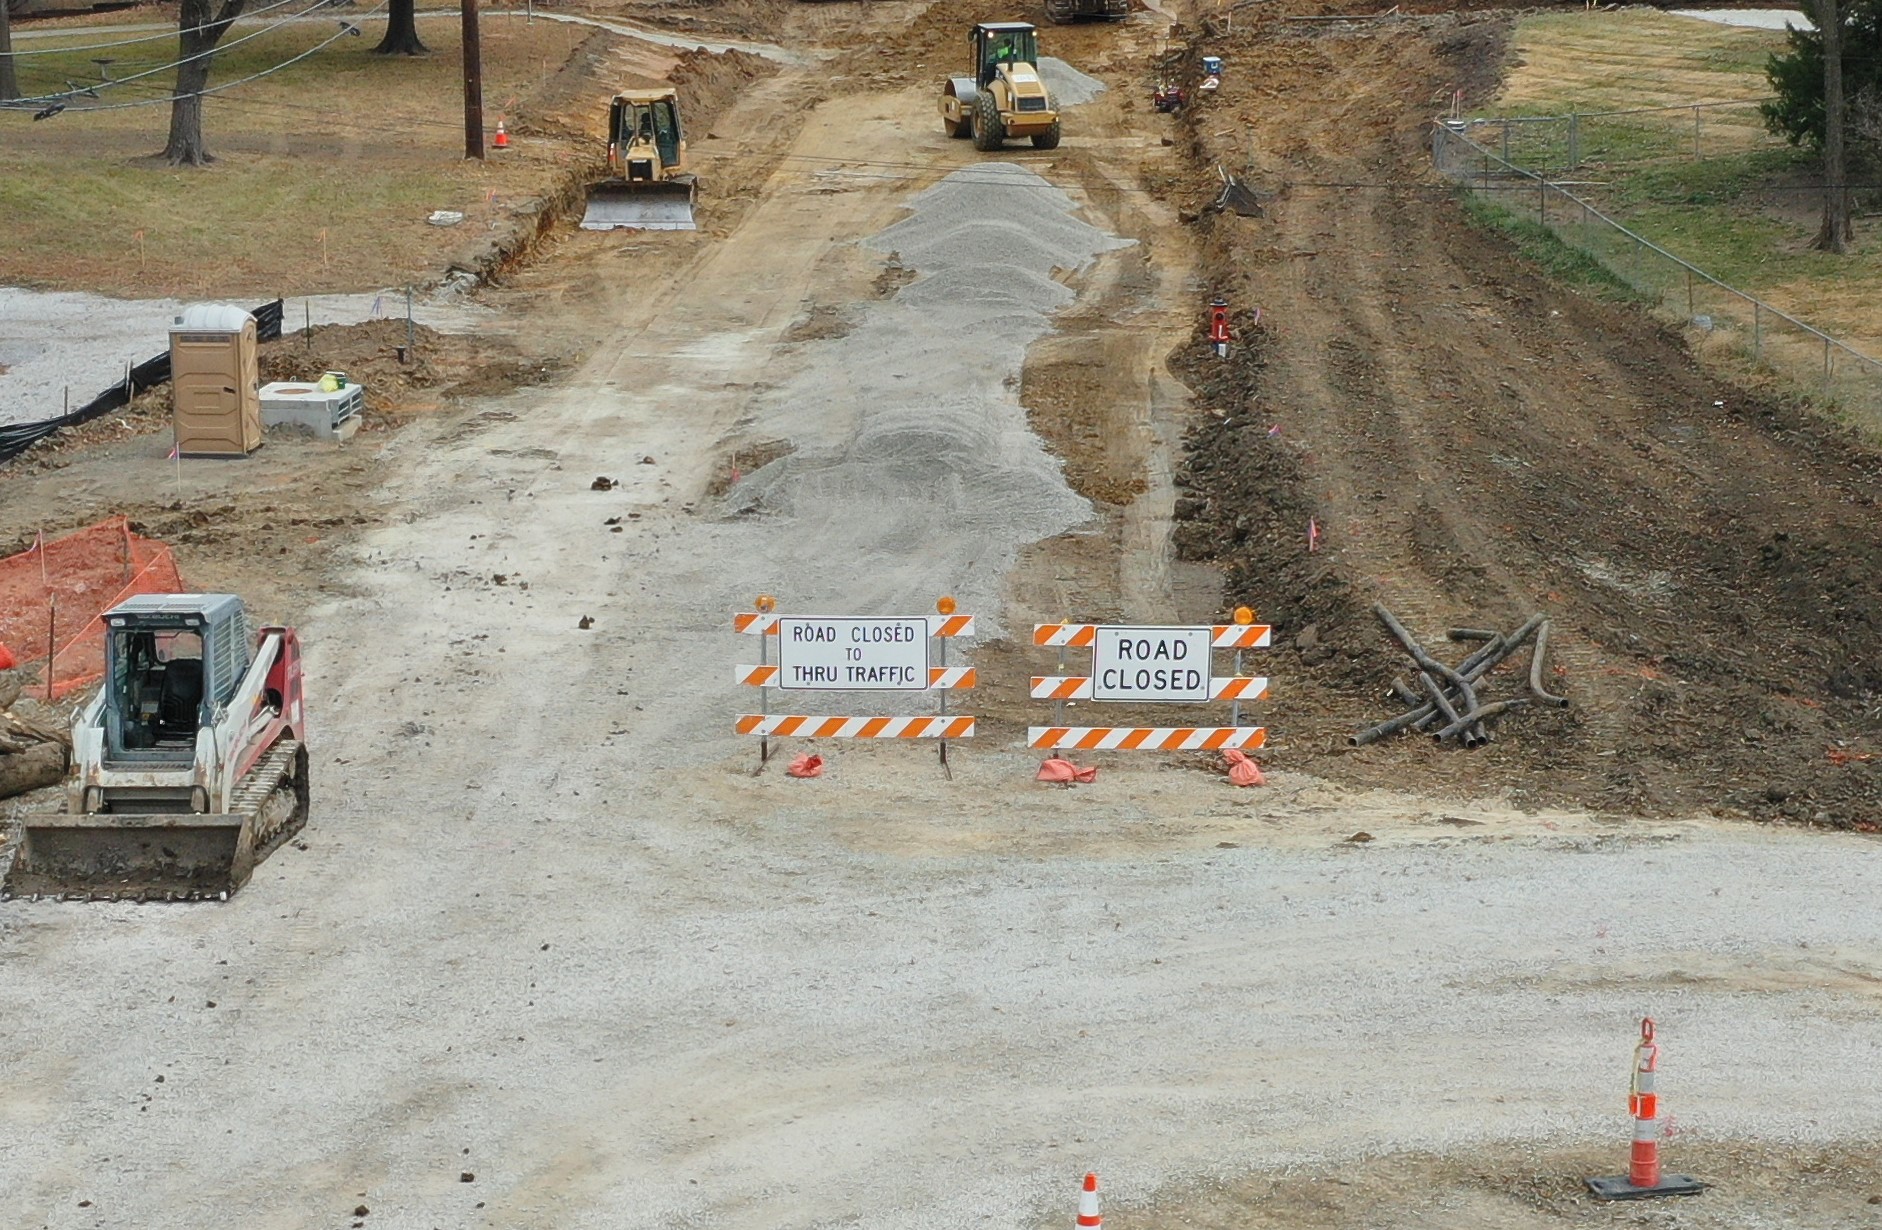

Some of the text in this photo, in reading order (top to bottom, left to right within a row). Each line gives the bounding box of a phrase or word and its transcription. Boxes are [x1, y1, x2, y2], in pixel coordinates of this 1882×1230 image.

[793, 626, 915, 642] ROAD CLOSED
[845, 647, 862, 661] TO
[1118, 639, 1188, 660] ROAD
[792, 666, 916, 682] THRU TRAFFIC
[1102, 669, 1201, 690] CLOSED
